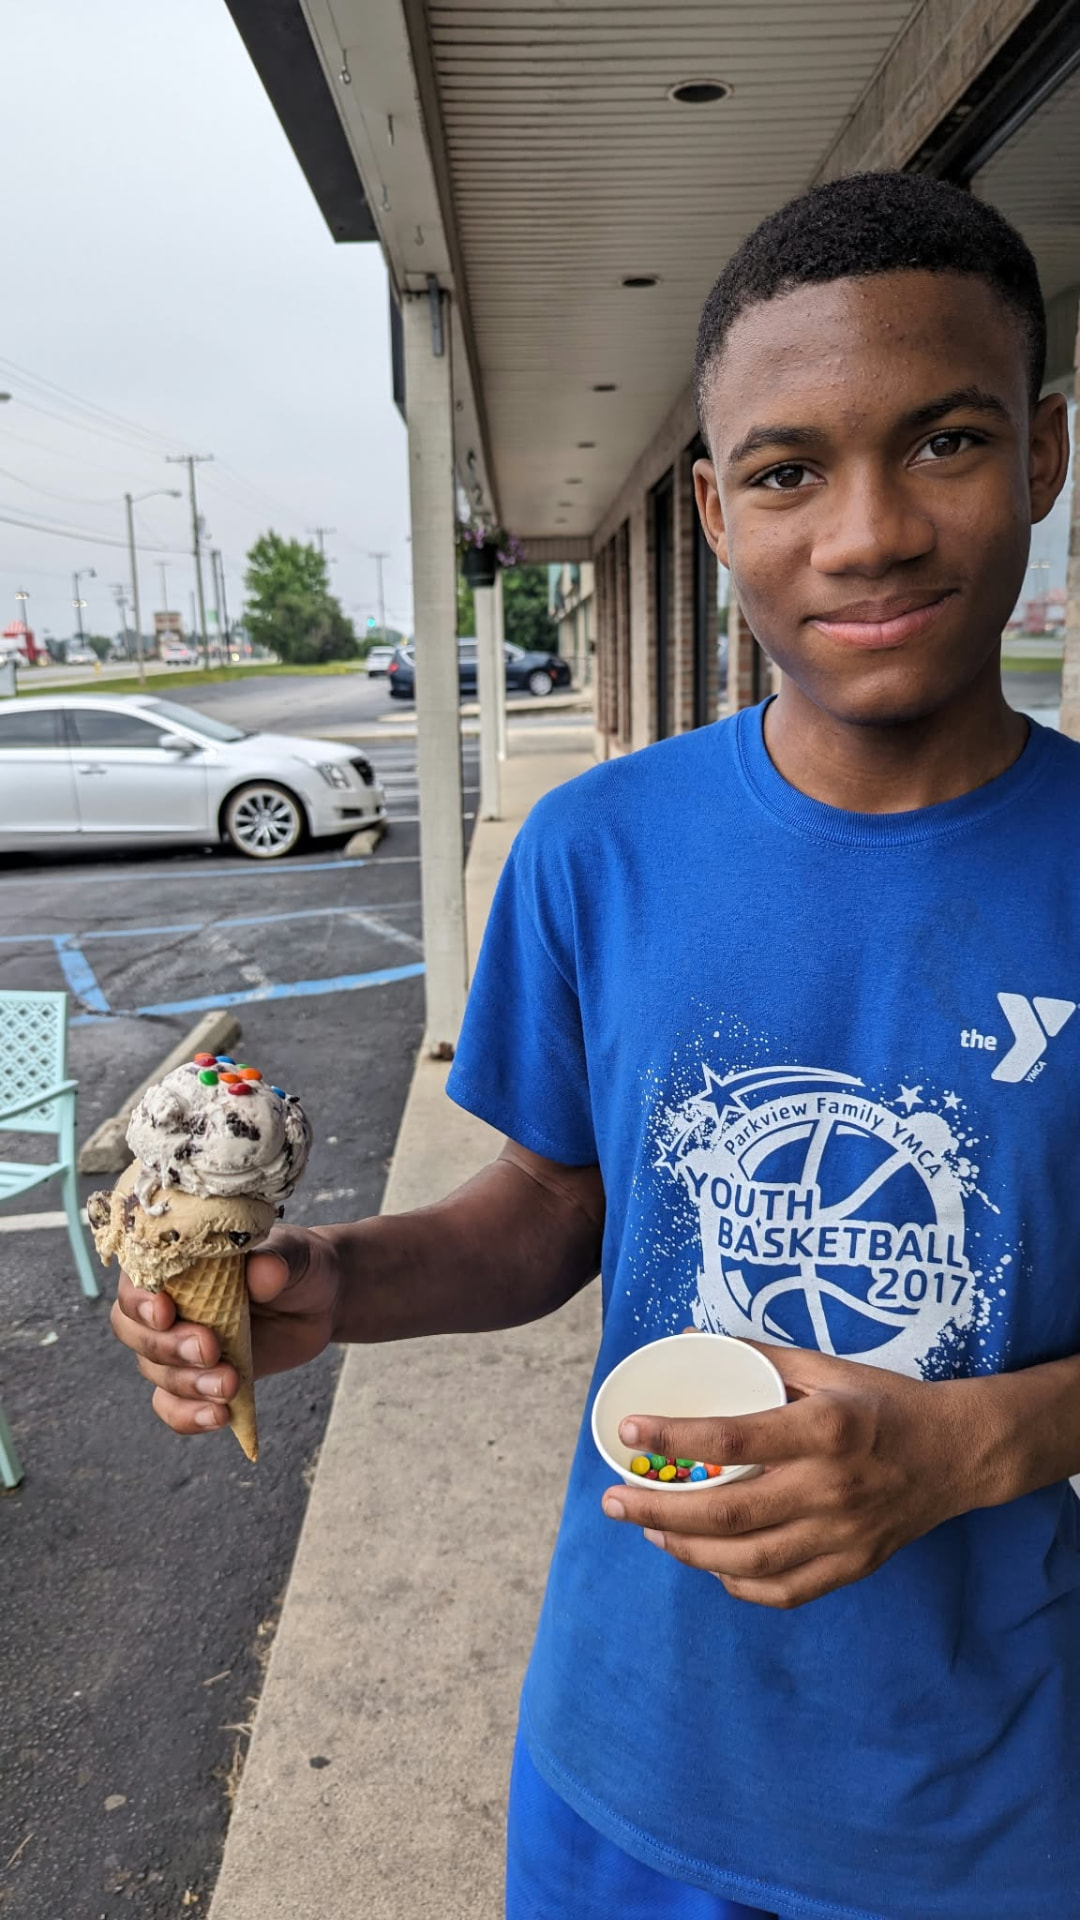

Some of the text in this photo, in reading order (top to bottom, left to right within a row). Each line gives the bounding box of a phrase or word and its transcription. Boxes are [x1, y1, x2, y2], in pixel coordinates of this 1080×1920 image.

[960, 1028, 998, 1051] the
[1025, 1060, 1048, 1083] YMCA
[724, 1097, 942, 1180] Parkview Family YMCA
[685, 1165, 814, 1221] YOUTH
[717, 1216, 964, 1269] BASKETBALL
[875, 1268, 969, 1306] 2017
